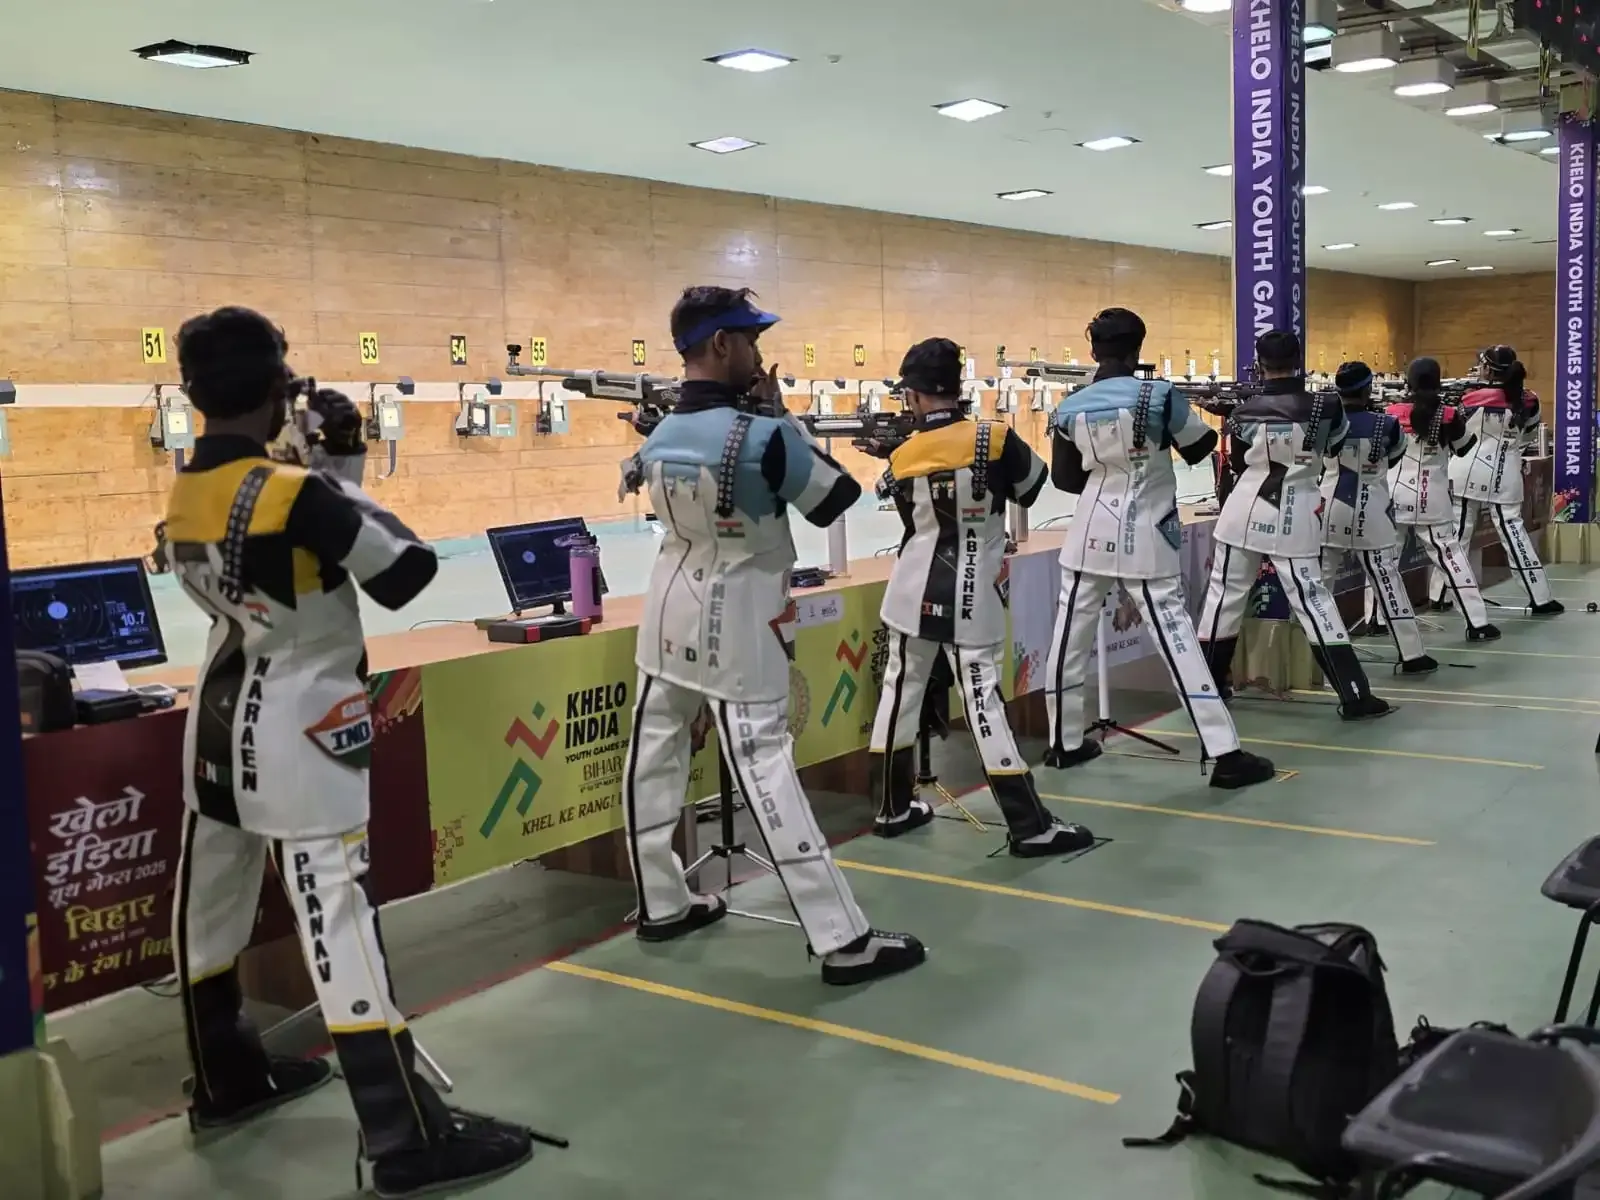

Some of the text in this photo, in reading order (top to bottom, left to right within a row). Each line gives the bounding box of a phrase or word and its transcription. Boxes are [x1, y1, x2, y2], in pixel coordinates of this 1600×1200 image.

[1291, 93, 1300, 170] INDIA
[1250, 0, 1274, 338] KHELO INDIA YOUTH GAM
[1292, 180, 1301, 274] YOUTH
[1565, 142, 1585, 476] KHELO INDIA YOUTH GAMES 2025 BIHAR
[145, 332, 162, 358] 51
[362, 336, 377, 360] 53
[452, 339, 466, 362] 54
[534, 341, 545, 361] 55
[633, 342, 645, 362] 56
[1282, 485, 1295, 535] BHANU
[1356, 483, 1369, 537] KHYATI
[1420, 469, 1430, 514] MAYURI
[1250, 521, 1276, 534] IND
[961, 527, 977, 621] ABISHEK
[1373, 550, 1399, 616] HUDHARY
[121, 611, 146, 626] 10.7
[1157, 599, 1187, 655] KUMAR
[241, 656, 271, 792] NARAEN
[566, 681, 627, 720] KHELO
[968, 661, 992, 739] SEKHAR
[330, 720, 371, 751] IND
[565, 711, 619, 750] INDIA
[565, 749, 592, 765] YOUTH
[593, 740, 620, 756] GAMES
[583, 755, 623, 781] BIHAR
[48, 785, 146, 839] खेलो
[522, 814, 555, 837] KHEL
[559, 806, 575, 825] KE
[578, 794, 616, 819] RANG!
[44, 828, 158, 885] इंडिया
[48, 859, 168, 909] यूथ गेम्स 2025
[65, 893, 157, 941] बिहार
[293, 851, 332, 983] PRANAV
[65, 960, 86, 984] के
